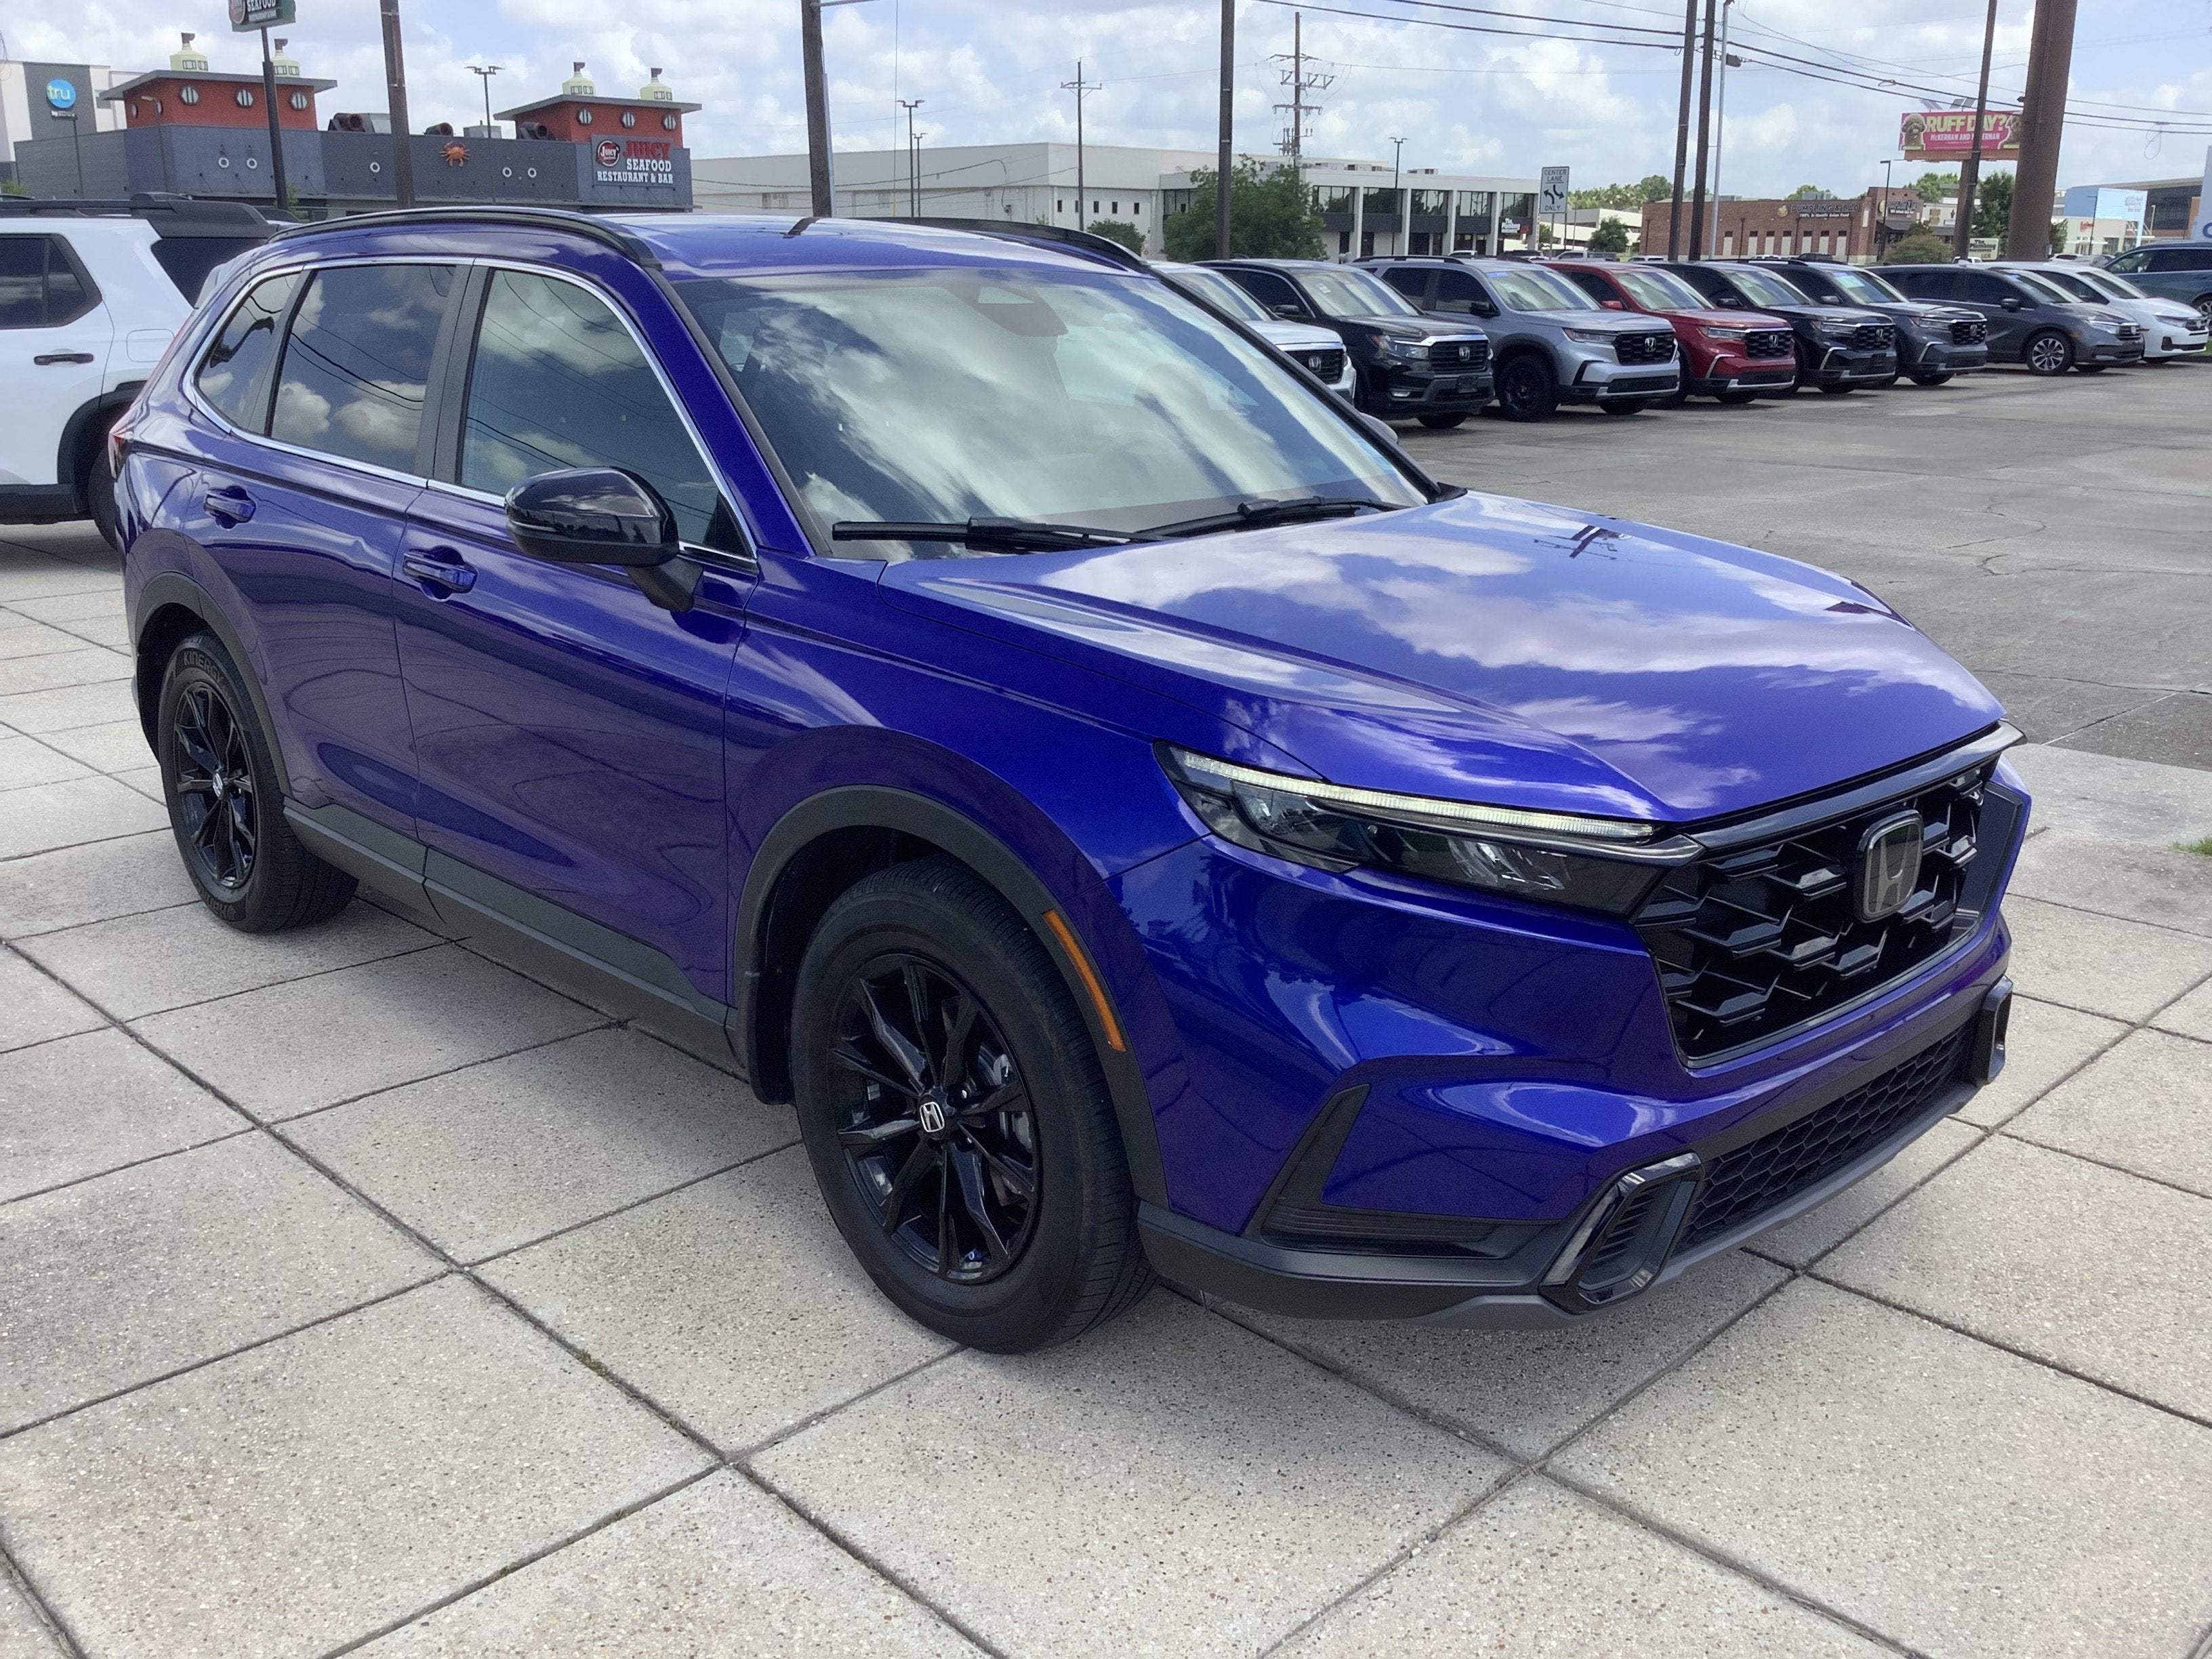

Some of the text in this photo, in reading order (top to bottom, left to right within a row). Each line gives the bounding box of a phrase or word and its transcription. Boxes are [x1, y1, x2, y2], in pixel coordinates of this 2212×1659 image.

[47, 85, 70, 100] tru
[1926, 115, 1966, 132] RUFF
[622, 141, 671, 159] JUICY
[626, 159, 672, 172] SEAFOOD
[597, 171, 673, 184] RESTAURANT & BAR
[1791, 204, 1832, 212] DUMPLING
